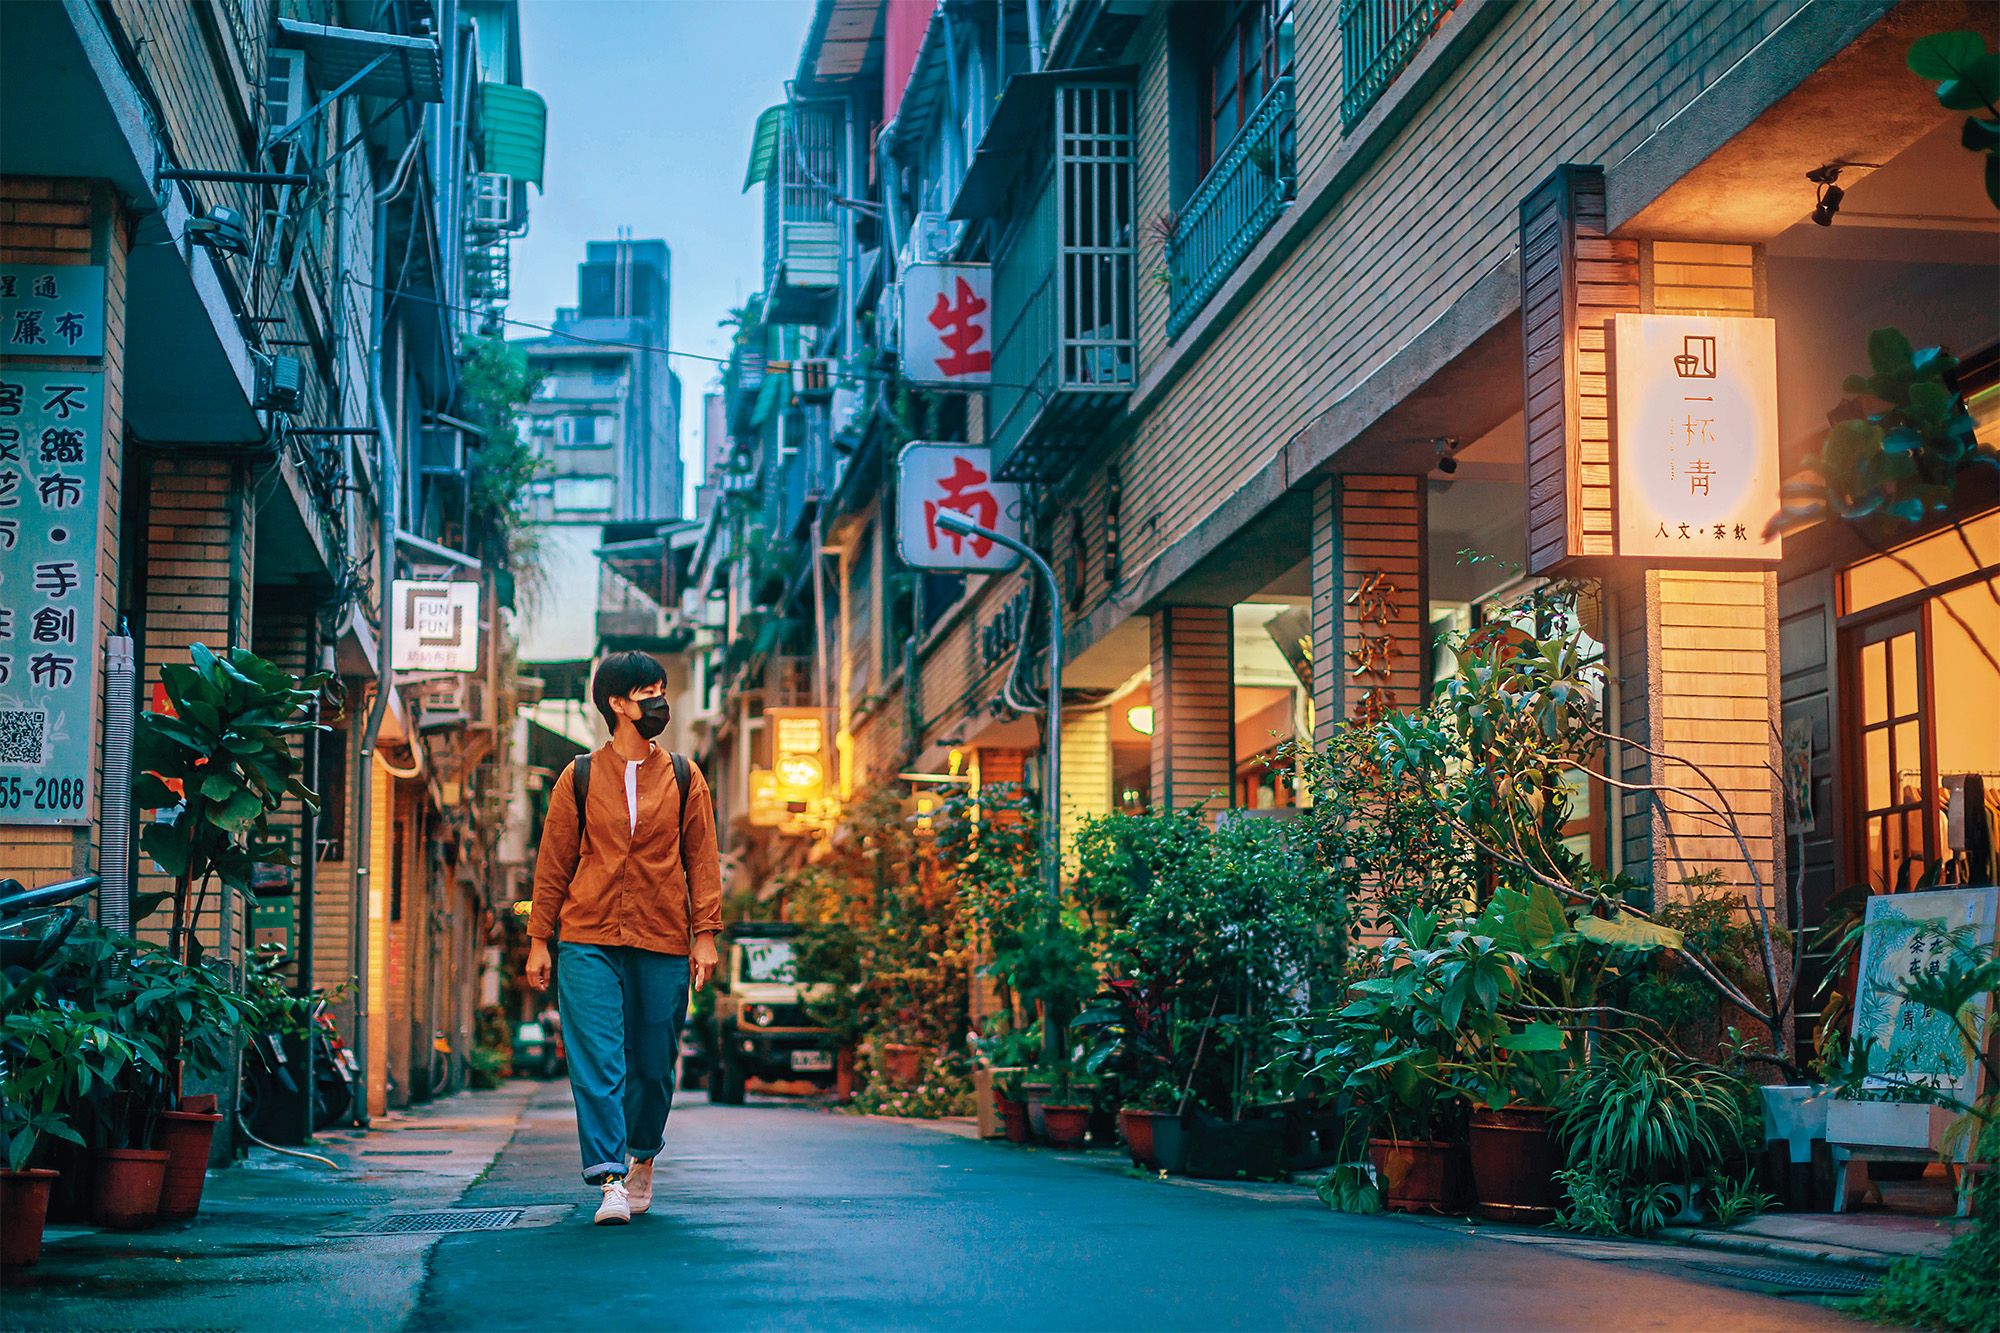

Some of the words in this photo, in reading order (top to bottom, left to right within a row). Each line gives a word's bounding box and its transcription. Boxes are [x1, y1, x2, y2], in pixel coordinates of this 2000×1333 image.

[927, 275, 991, 377] 生
[1681, 396, 1717, 497] 一杯青
[924, 456, 998, 558] 南
[418, 602, 449, 616] FUN
[418, 620, 448, 633] FUN
